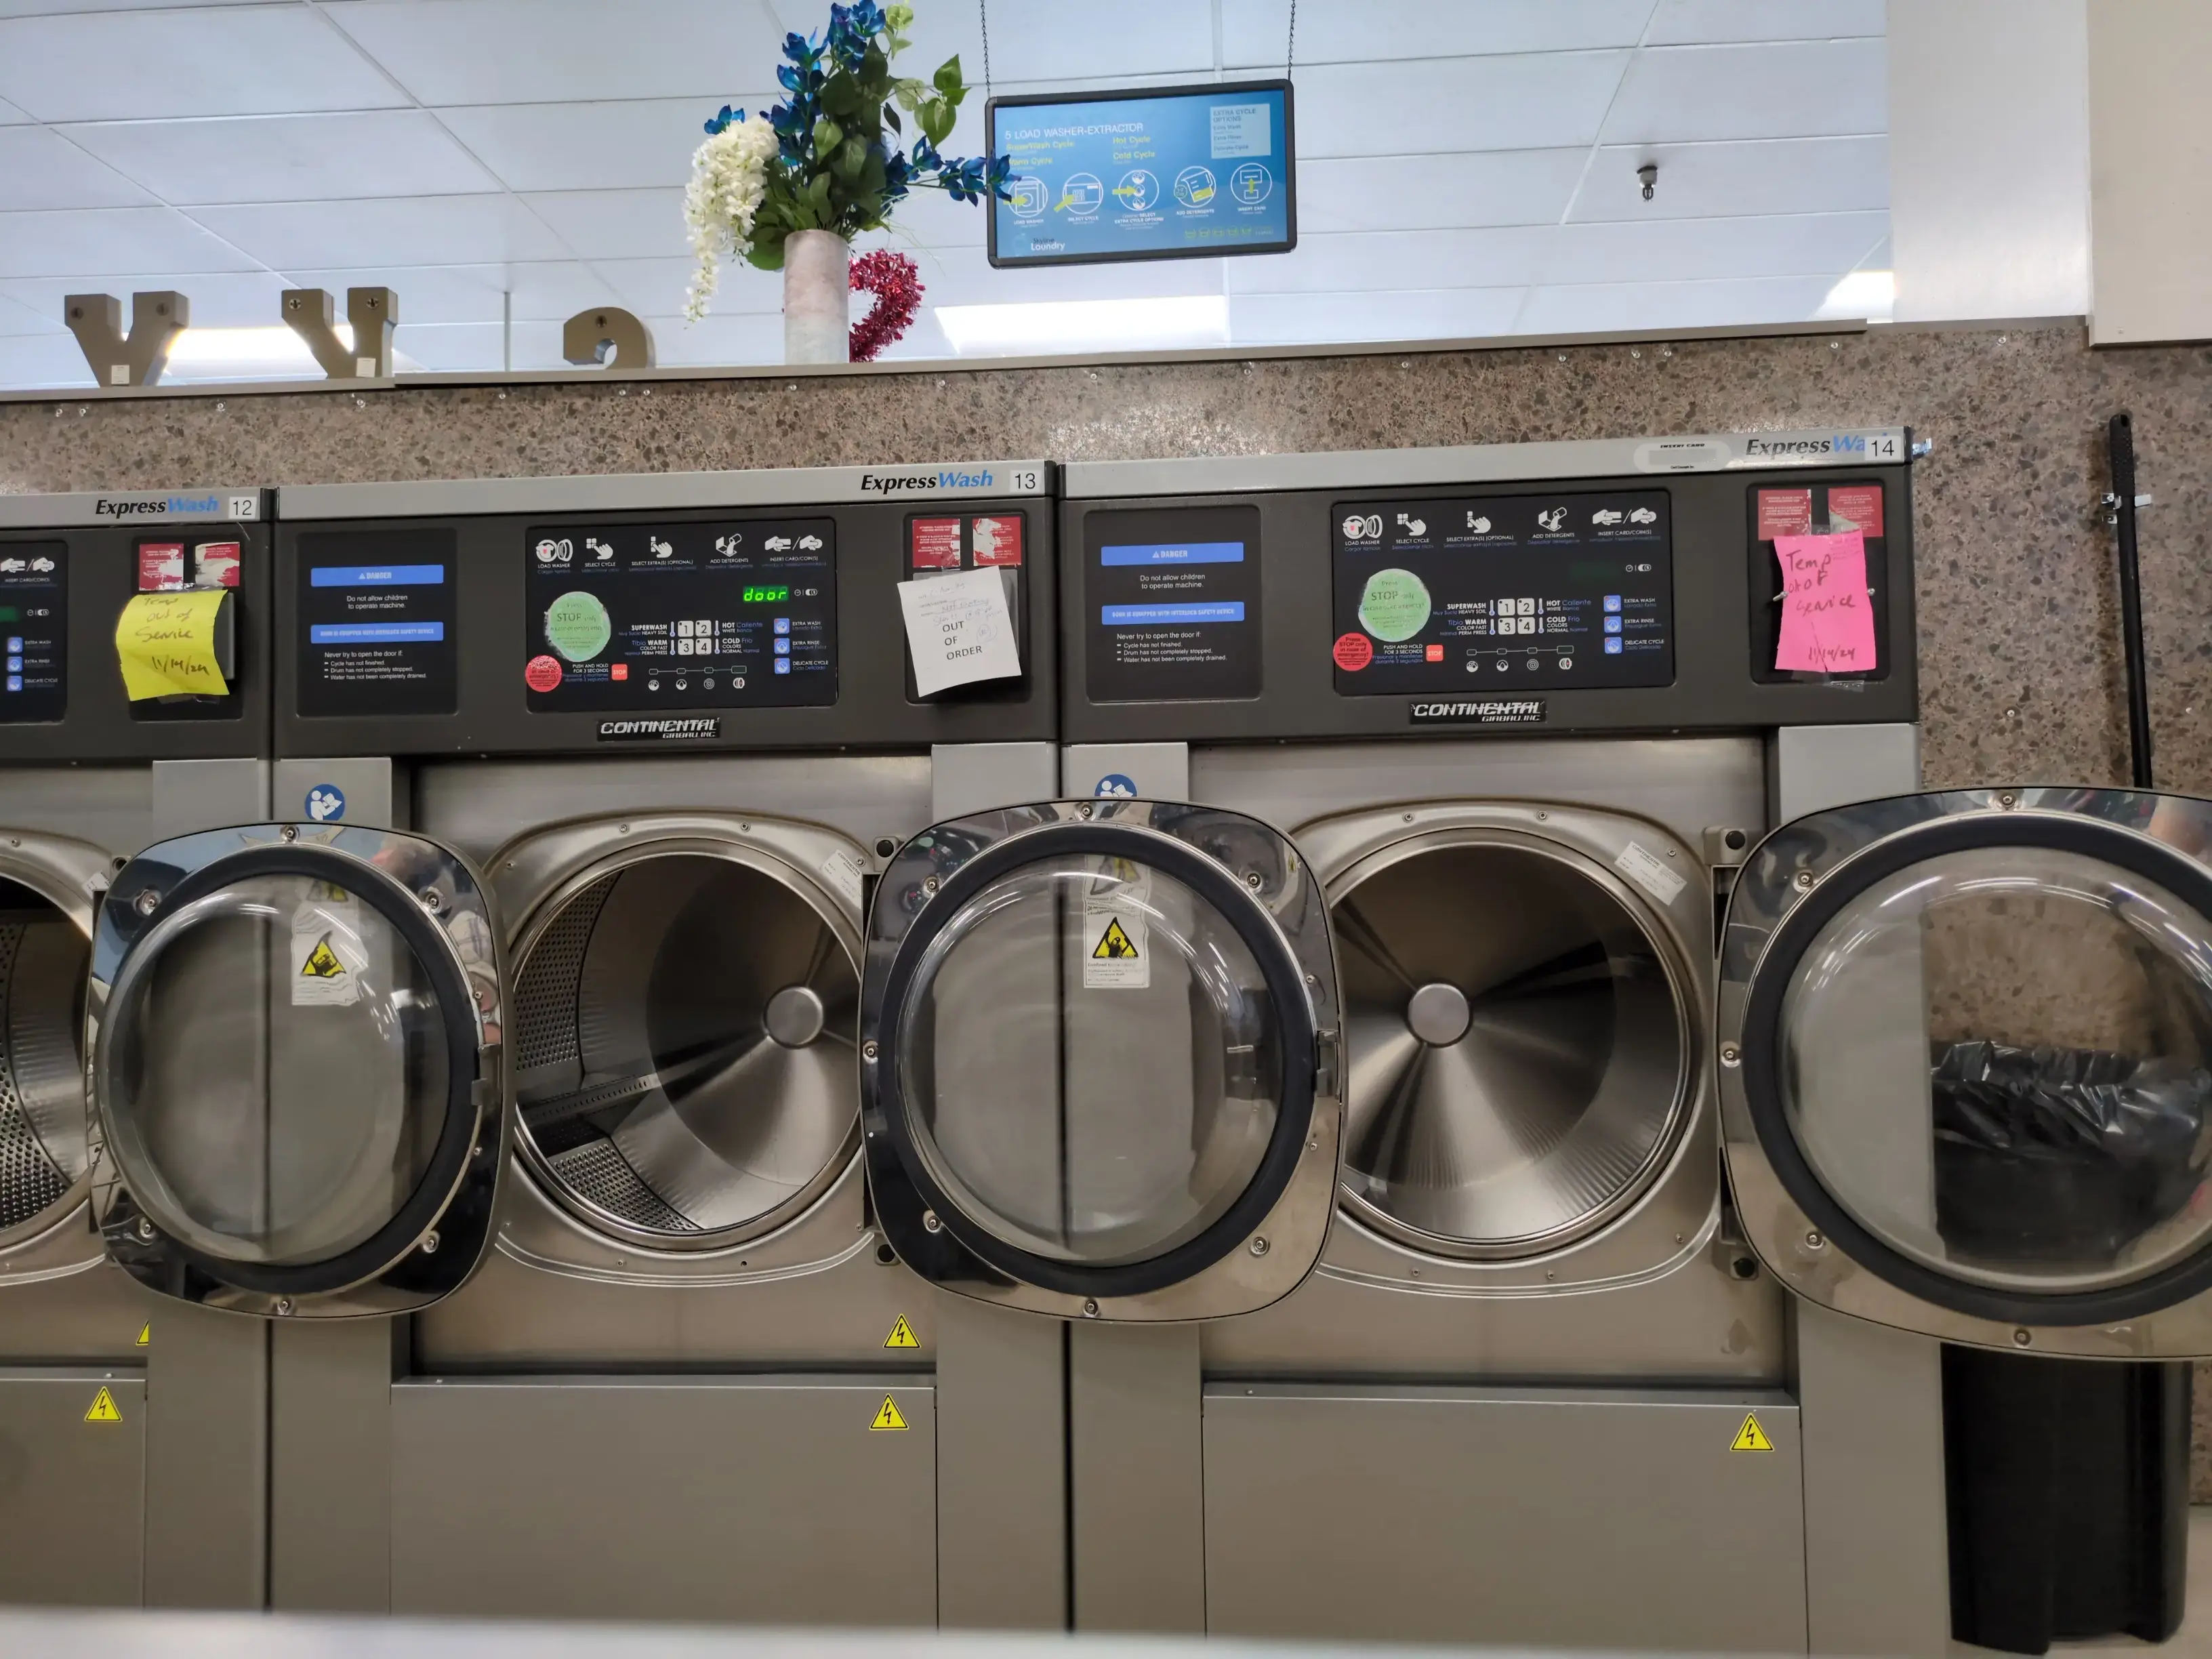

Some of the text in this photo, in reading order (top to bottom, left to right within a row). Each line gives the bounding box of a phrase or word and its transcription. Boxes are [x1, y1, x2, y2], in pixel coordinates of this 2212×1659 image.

[1005, 123, 1143, 140] 5 LOAD WASHER-EXTRACTOR
[1052, 140, 1074, 150] Cycle
[1113, 136, 1151, 144] Hot Cycle
[1113, 150, 1155, 160] Cold Cycle
[1031, 157, 1052, 165] Cycle
[1031, 242, 1065, 251] Laundry
[1746, 434, 1887, 459] ExpressWa
[1870, 439, 1895, 457] 14
[1015, 473, 1036, 489] 13
[232, 500, 252, 516] 12
[1786, 550, 1831, 573] Temp
[1149, 583, 1174, 591] operate
[743, 588, 787, 602] door
[1371, 591, 1398, 601] STOP
[1523, 603, 1530, 613] 2
[701, 624, 708, 634] 2
[943, 621, 964, 633] OUT
[1504, 622, 1511, 632] 3
[1523, 621, 1530, 631] 4
[945, 636, 958, 646] OF
[1153, 633, 1168, 641] open
[683, 643, 690, 653] 3
[701, 643, 708, 653] 4
[946, 645, 983, 660] ORDER
[1809, 645, 1856, 664] 11/14/24
[1414, 702, 1540, 716] CONTINENTAL
[600, 718, 716, 734] CONTINENTAL
